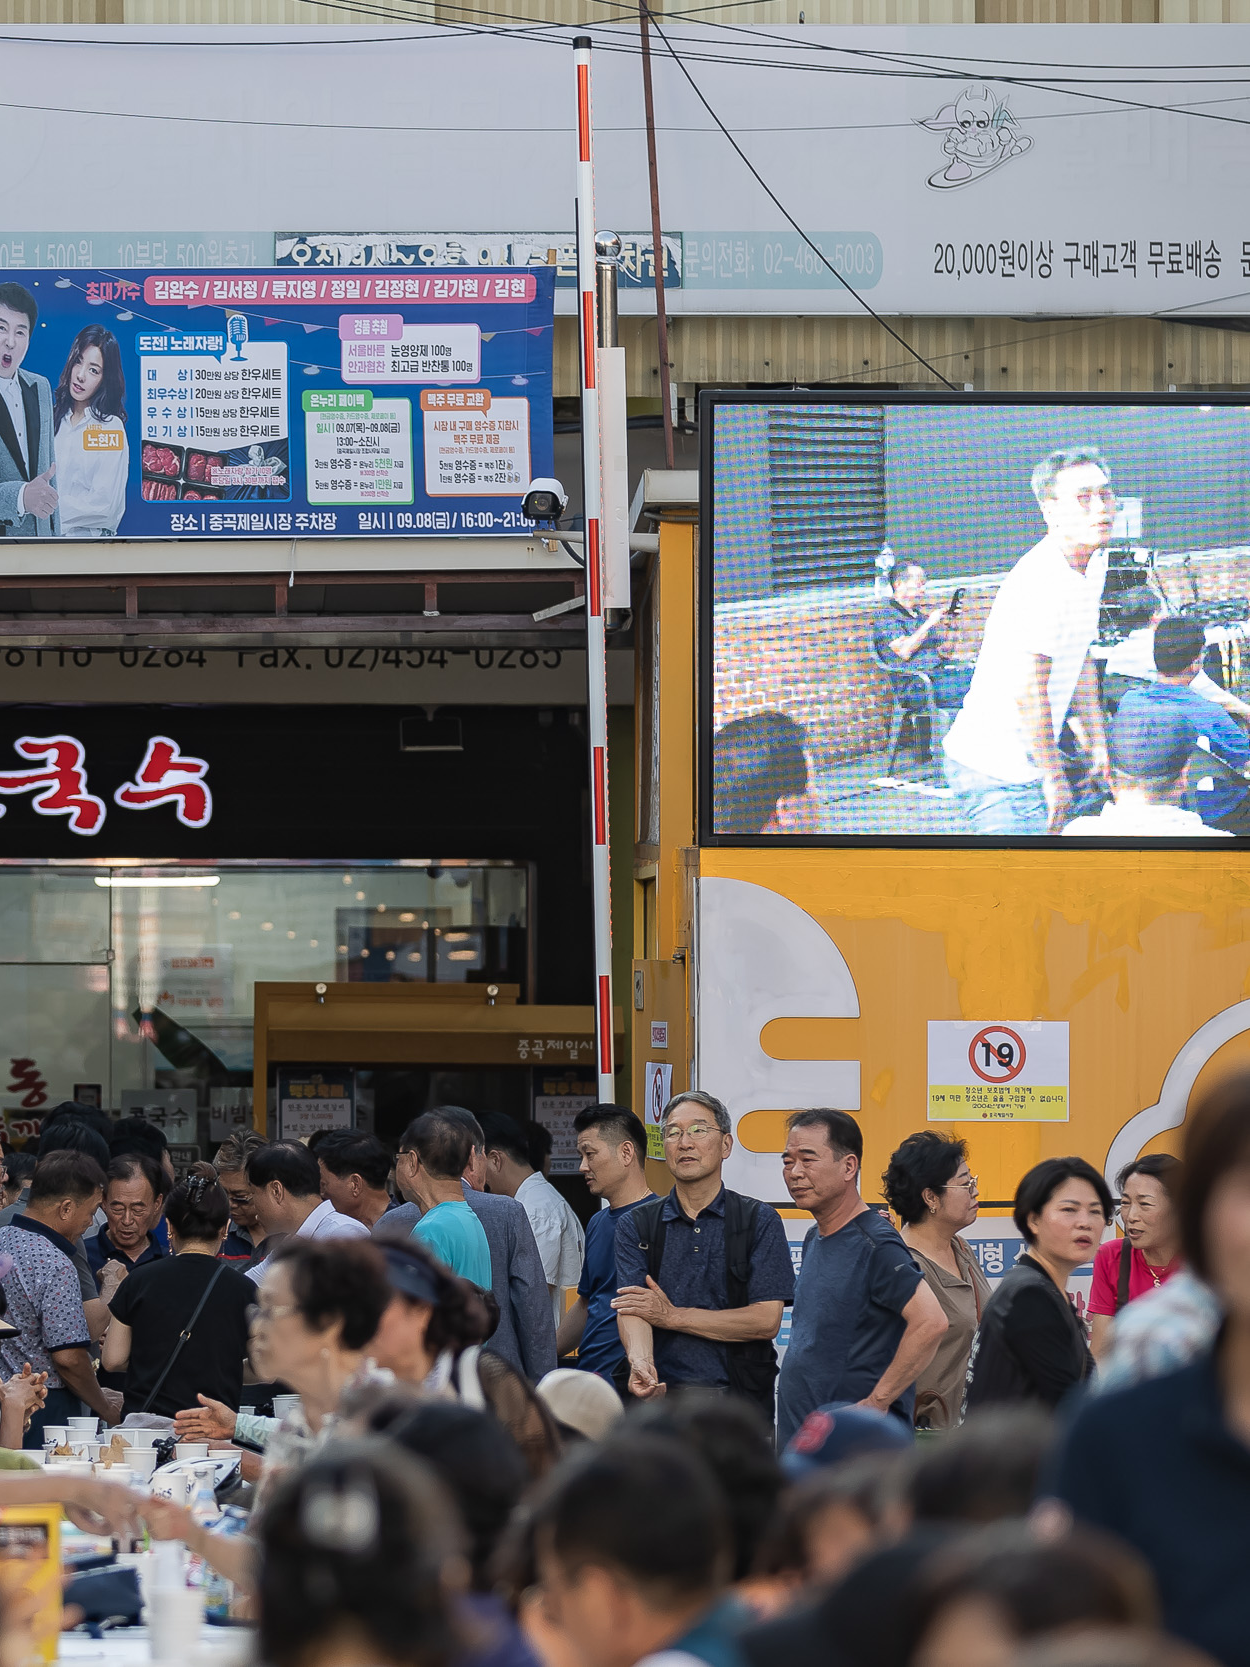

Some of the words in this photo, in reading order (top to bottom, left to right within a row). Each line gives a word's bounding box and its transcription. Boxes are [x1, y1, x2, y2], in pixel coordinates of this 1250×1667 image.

[763, 242, 875, 274] 02-466-5003
[933, 239, 1054, 281] 20,000원이상
[1063, 239, 1138, 279] 구매고객
[1147, 239, 1223, 279] 무료배송
[86, 281, 141, 301] 초대가수
[153, 280, 200, 300] 김완수
[212, 280, 259, 300] 김서정
[271, 279, 317, 299] 류지영
[330, 279, 361, 299] 정일
[374, 278, 420, 299] 김정현
[433, 278, 479, 298] 김가현
[494, 278, 526, 298] 김현
[139, 335, 168, 351] 도전!
[170, 335, 224, 351] 노래자랑!
[348, 344, 386, 357] 서울바른
[391, 344, 429, 357] 눈영양제
[195, 369, 222, 381] 30만원
[224, 372, 239, 381] 상당
[241, 368, 282, 381] 한우세트
[348, 360, 386, 374] 안과협찬
[391, 360, 419, 373] 최고급
[147, 388, 188, 400] 최우수상
[195, 388, 222, 400] 20만원
[224, 391, 239, 400] 상당
[241, 387, 282, 400] 한우세트
[195, 407, 220, 419] 15만원
[222, 410, 237, 419] 상당
[239, 406, 280, 419] 한우세트
[195, 426, 220, 438] 15만원
[222, 429, 237, 438] 상당
[240, 425, 281, 438] 한우세트
[87, 432, 119, 447] 노현지
[170, 513, 199, 531] 장소
[209, 513, 293, 531] 중곡제일시장
[295, 512, 337, 531] 주차장
[358, 512, 386, 530] 일시
[396, 511, 450, 530] 09.08(금)
[981, 1042, 1014, 1067] 19
